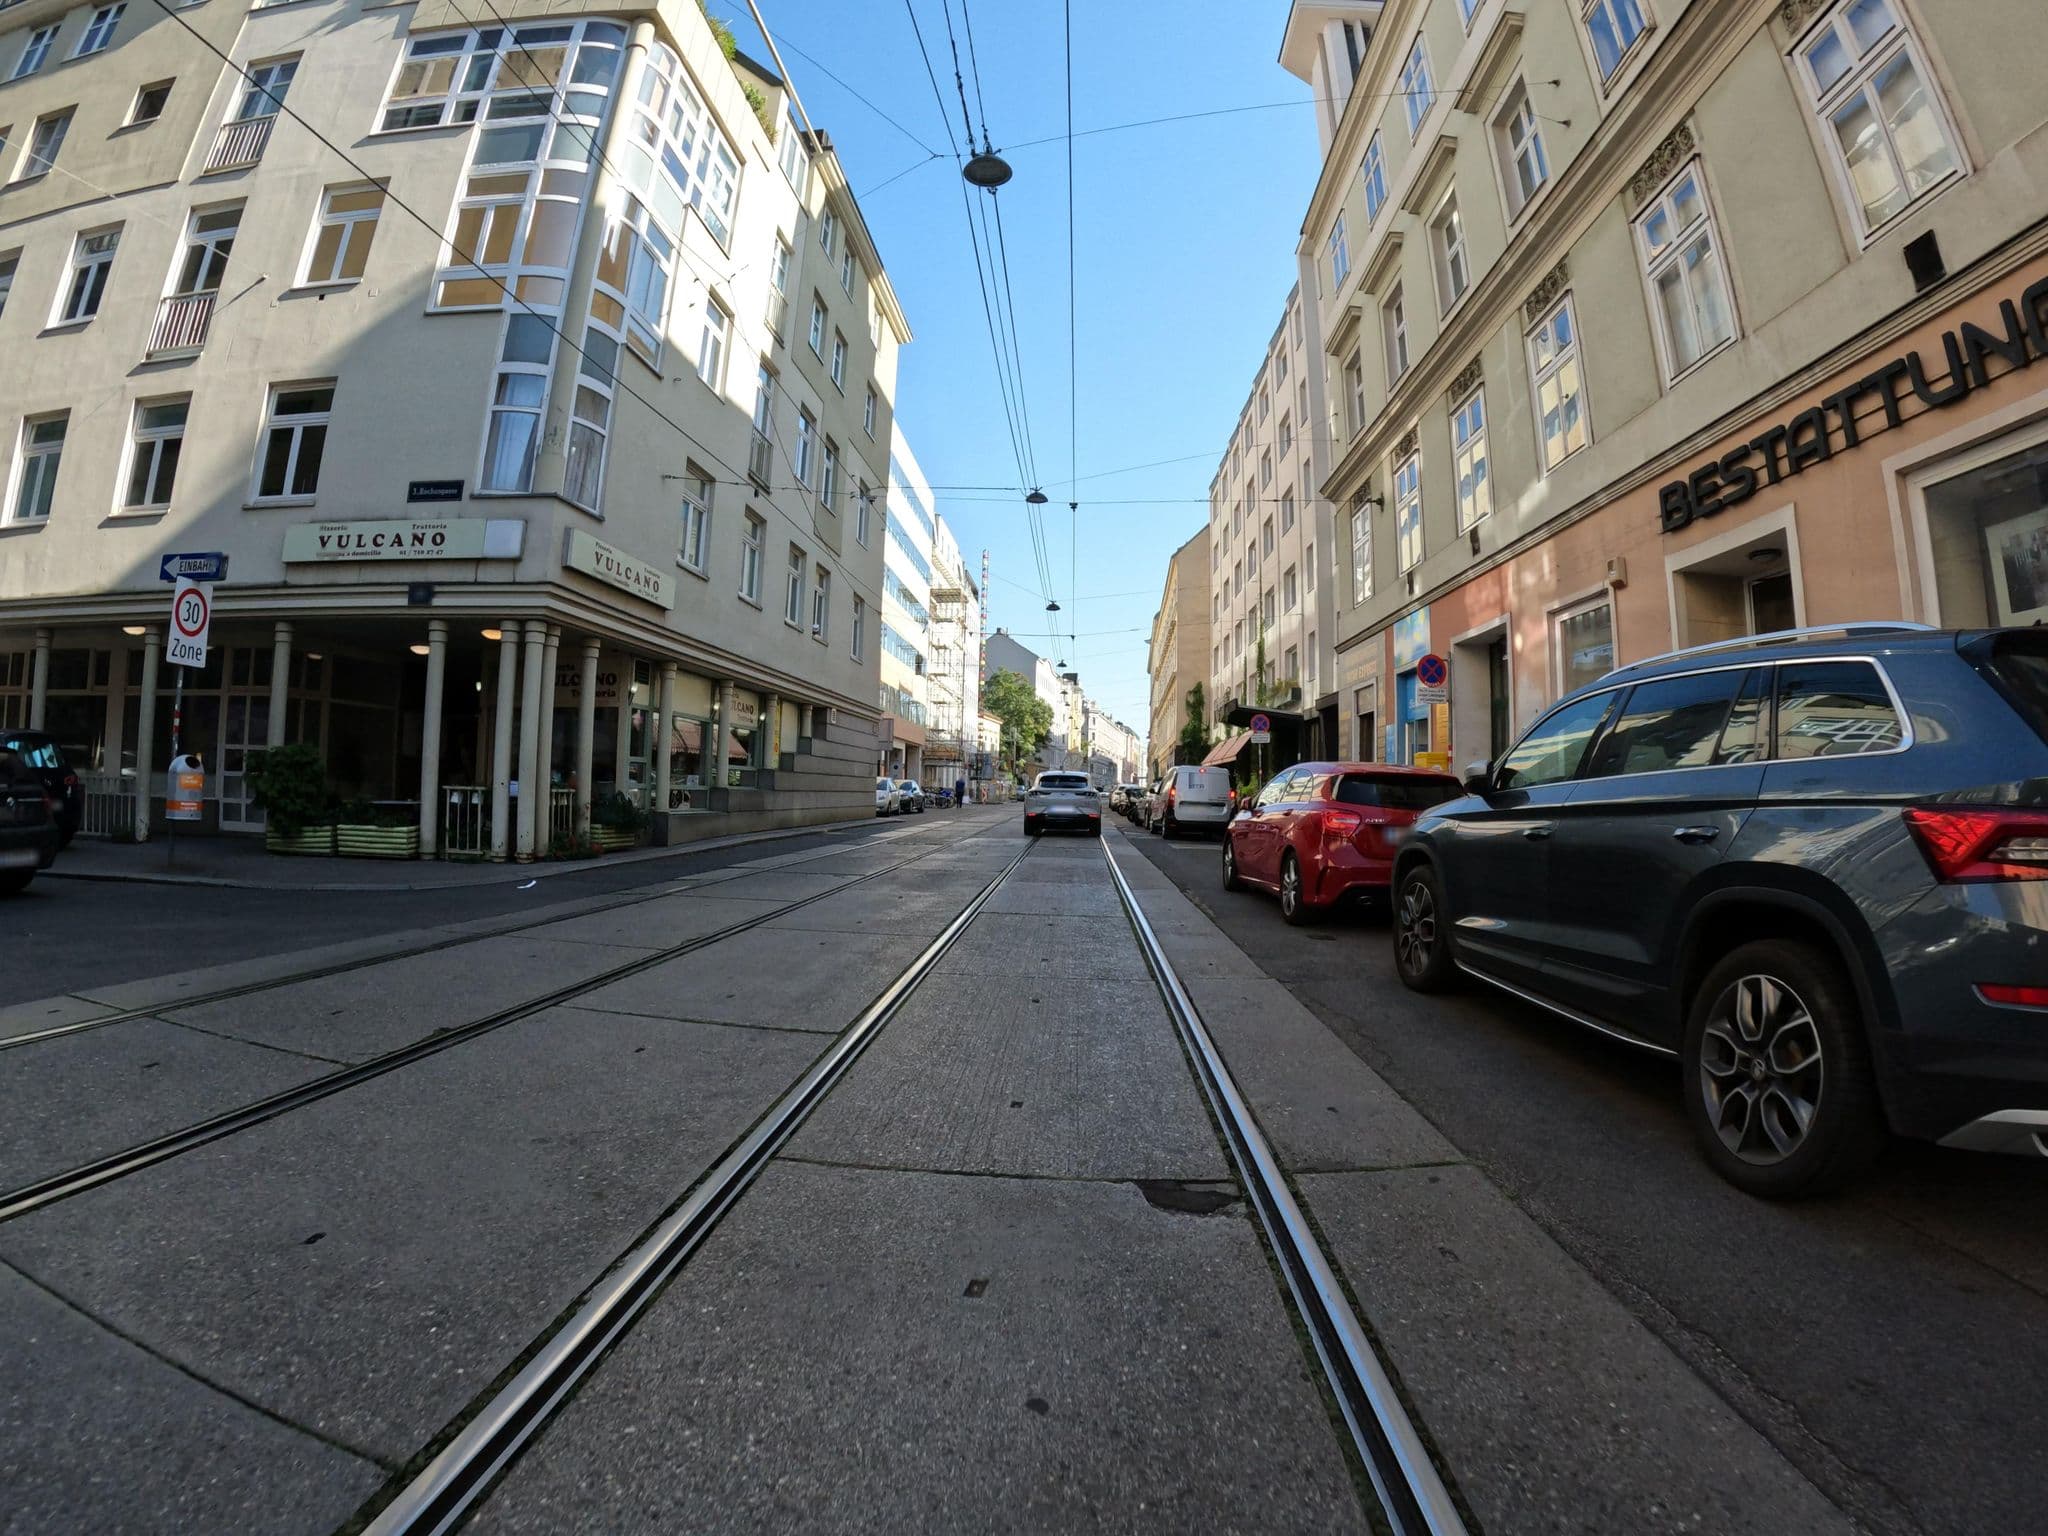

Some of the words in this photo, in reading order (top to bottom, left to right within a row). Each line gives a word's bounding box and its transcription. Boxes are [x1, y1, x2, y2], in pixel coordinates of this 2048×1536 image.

[319, 532, 446, 549] VULCANO
[595, 551, 660, 593] VULCANO
[183, 600, 200, 624] 30
[171, 638, 203, 661] Zone
